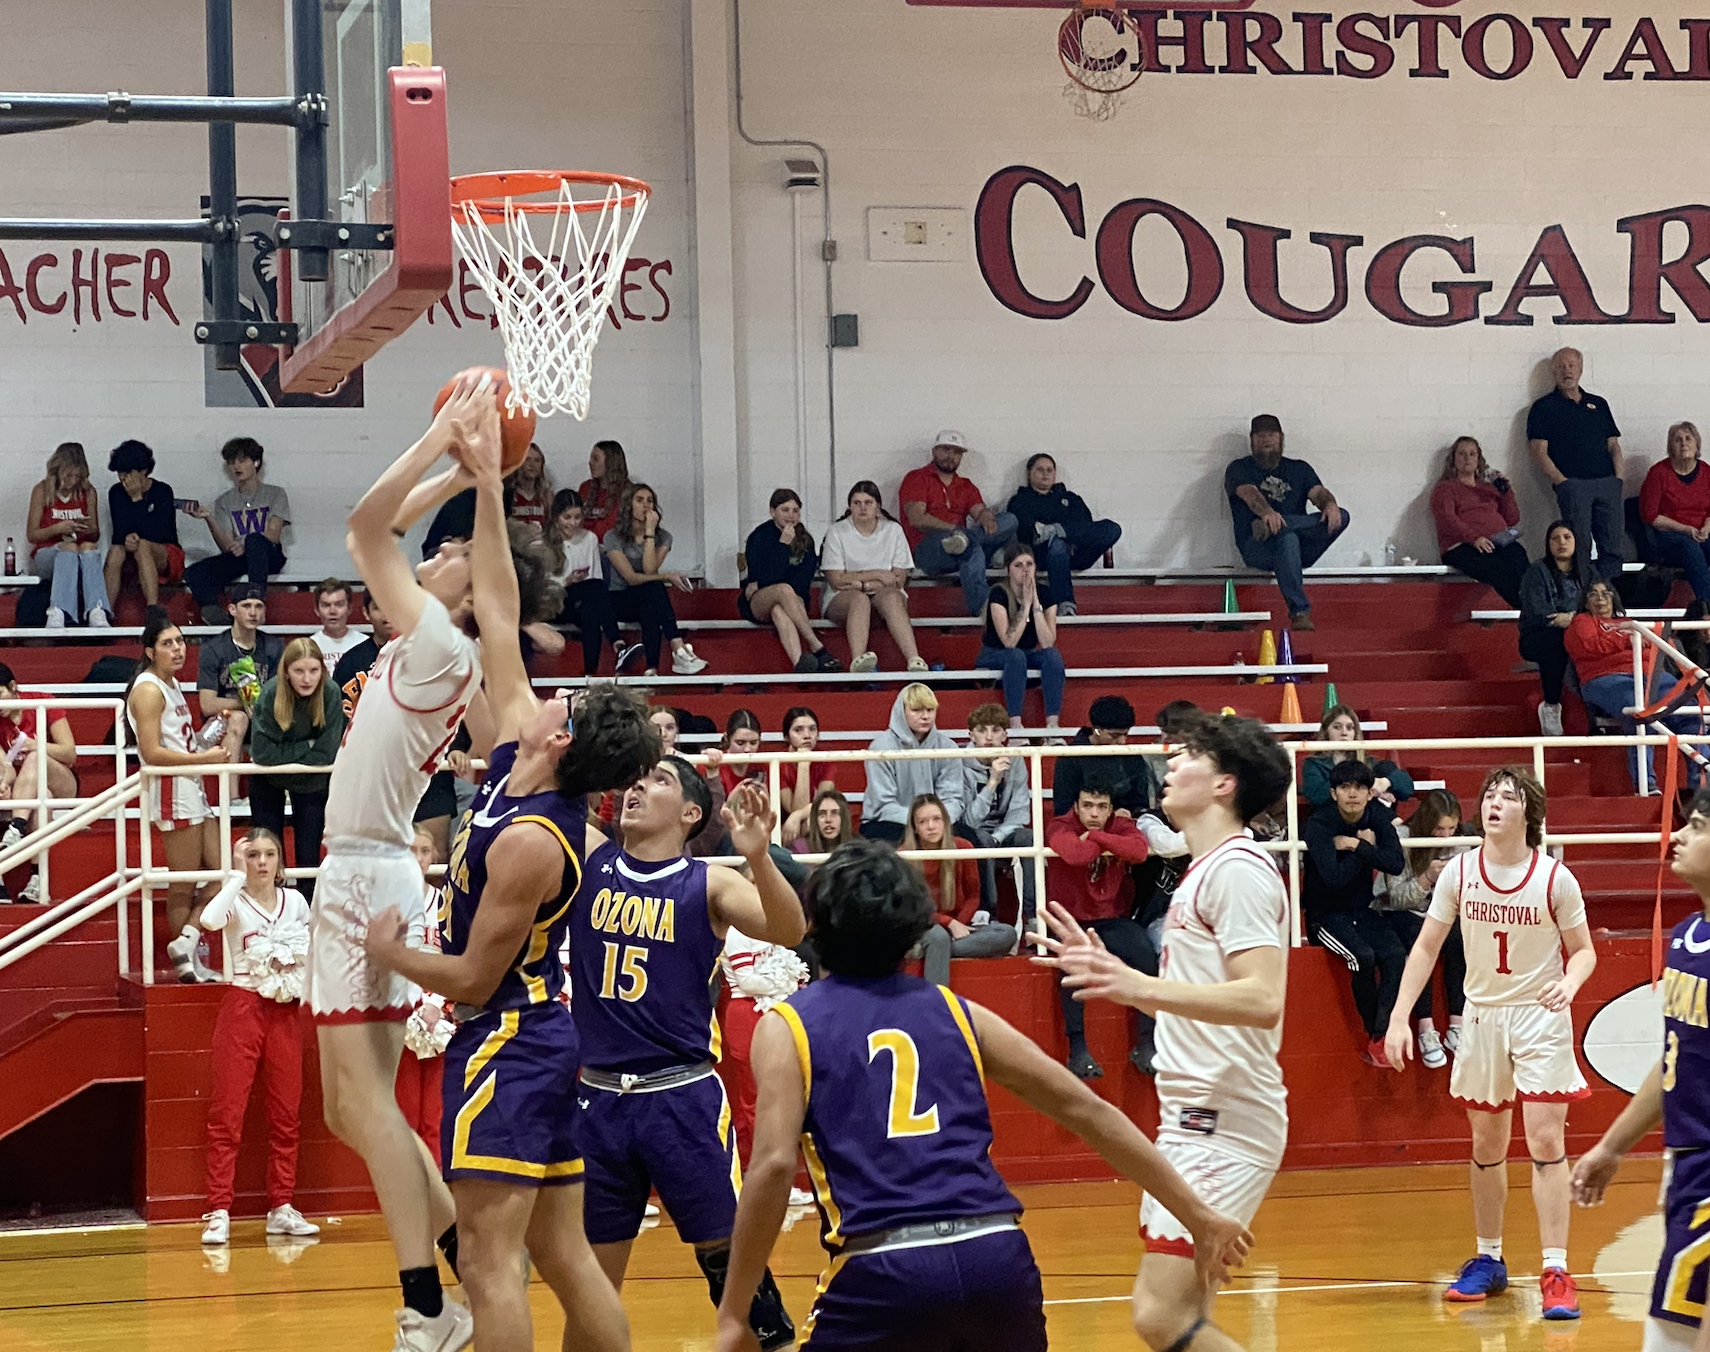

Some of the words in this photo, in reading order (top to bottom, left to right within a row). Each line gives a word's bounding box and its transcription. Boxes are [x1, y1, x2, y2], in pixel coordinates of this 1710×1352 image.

[231, 506, 269, 535] W
[590, 887, 675, 943] OZONA
[1465, 900, 1542, 926] CHRISTOVAL
[598, 941, 649, 1003] 15
[1492, 930, 1513, 975] 1
[867, 1028, 941, 1139] 2
